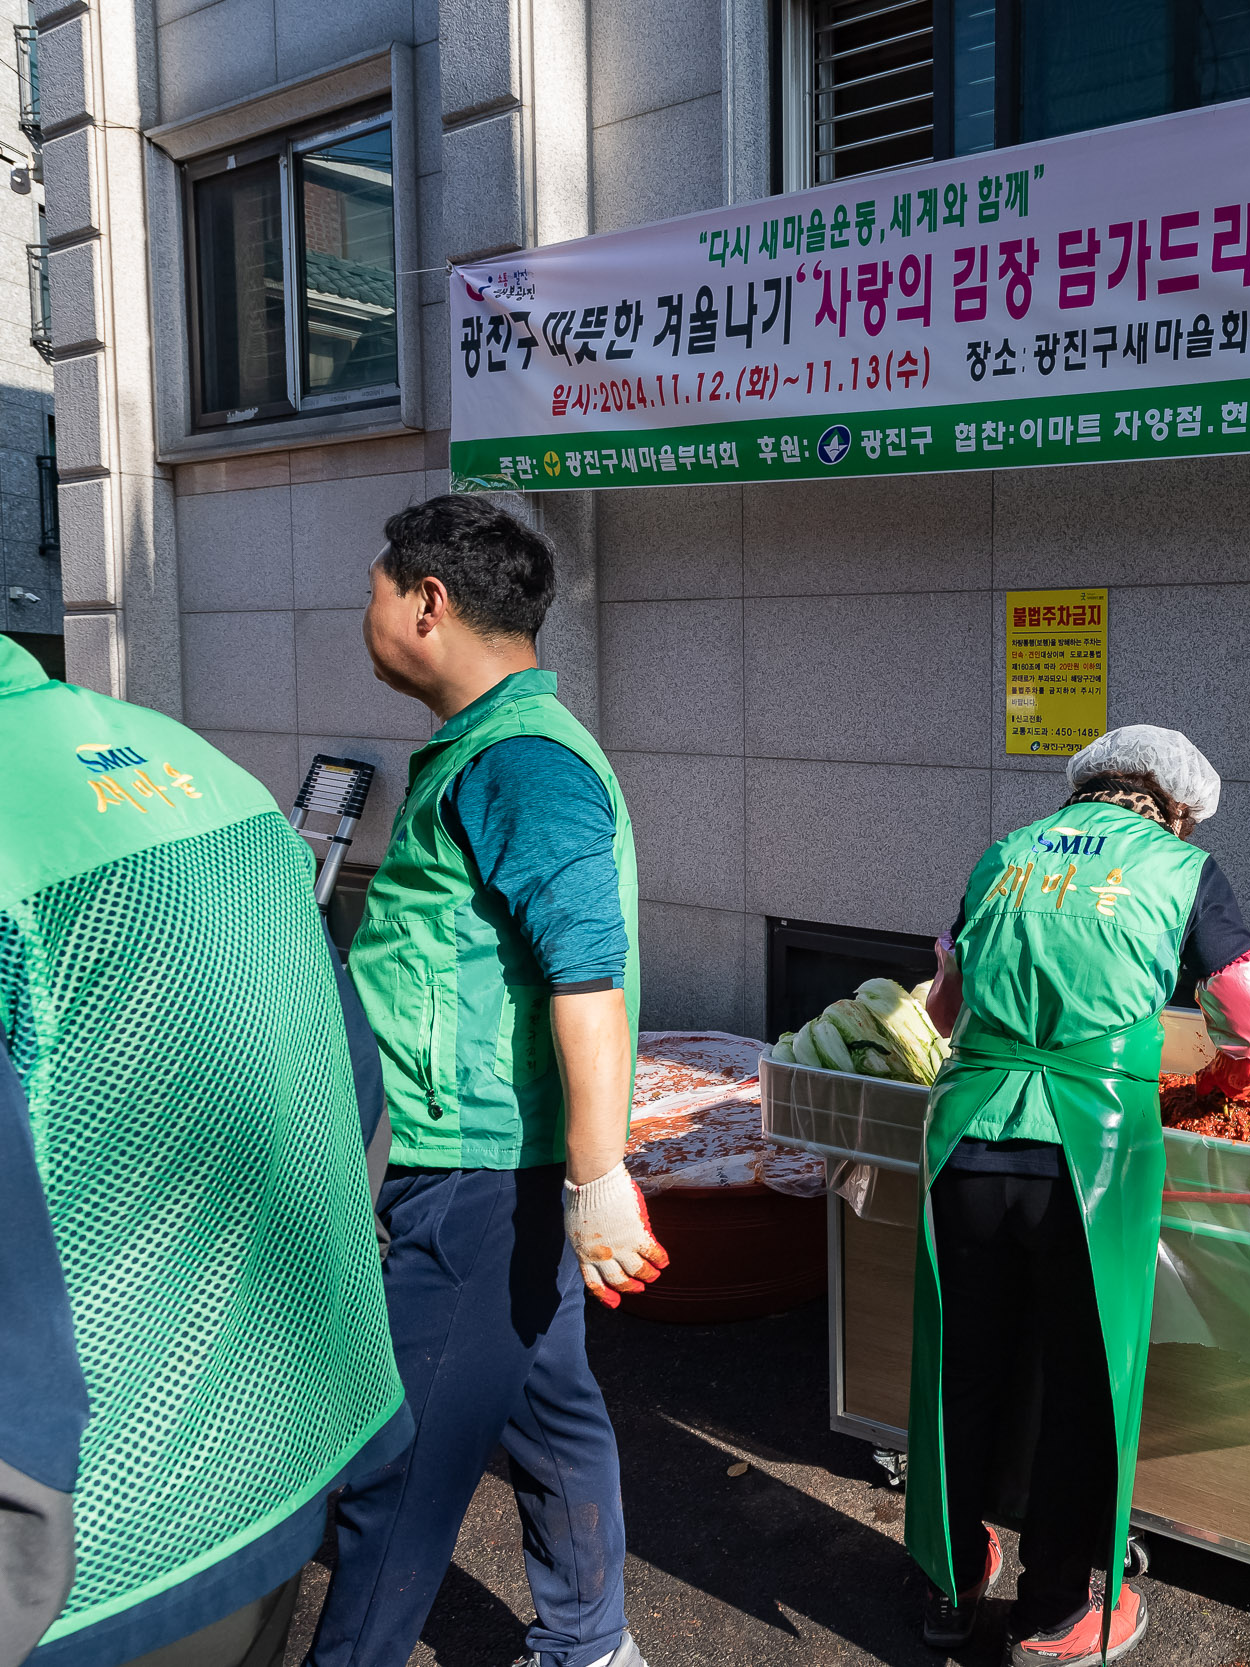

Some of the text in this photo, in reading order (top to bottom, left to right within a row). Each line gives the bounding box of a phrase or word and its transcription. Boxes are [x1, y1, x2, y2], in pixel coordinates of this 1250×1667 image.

[699, 163, 1045, 268] “다시 새마을운동,세계와 함께”
[460, 310, 539, 379] 광진구
[542, 298, 644, 367] 따뜻한
[653, 275, 793, 357] 겨울나기
[953, 237, 1040, 323] 김장
[499, 456, 539, 480] 주관:
[565, 441, 739, 478] 광진구새마을부녀회
[757, 434, 809, 465] 후원:
[860, 425, 933, 460] 광진구
[1013, 604, 1102, 627] 불법주차금지
[1083, 638, 1102, 646] 주차는
[1069, 650, 1101, 659] 도로교통법
[1044, 663, 1056, 671] 따라
[1038, 675, 1068, 683] 부과되오니
[1011, 687, 1101, 695] 불법주차를 금지하여 주시기
[1016, 715, 1042, 723] 신고전화
[1042, 743, 1083, 752] 광진구청장
[77, 747, 148, 773] SMU
[88, 763, 203, 813] 새마을
[1032, 833, 1108, 856] SMU
[986, 862, 1131, 917] 새마을
